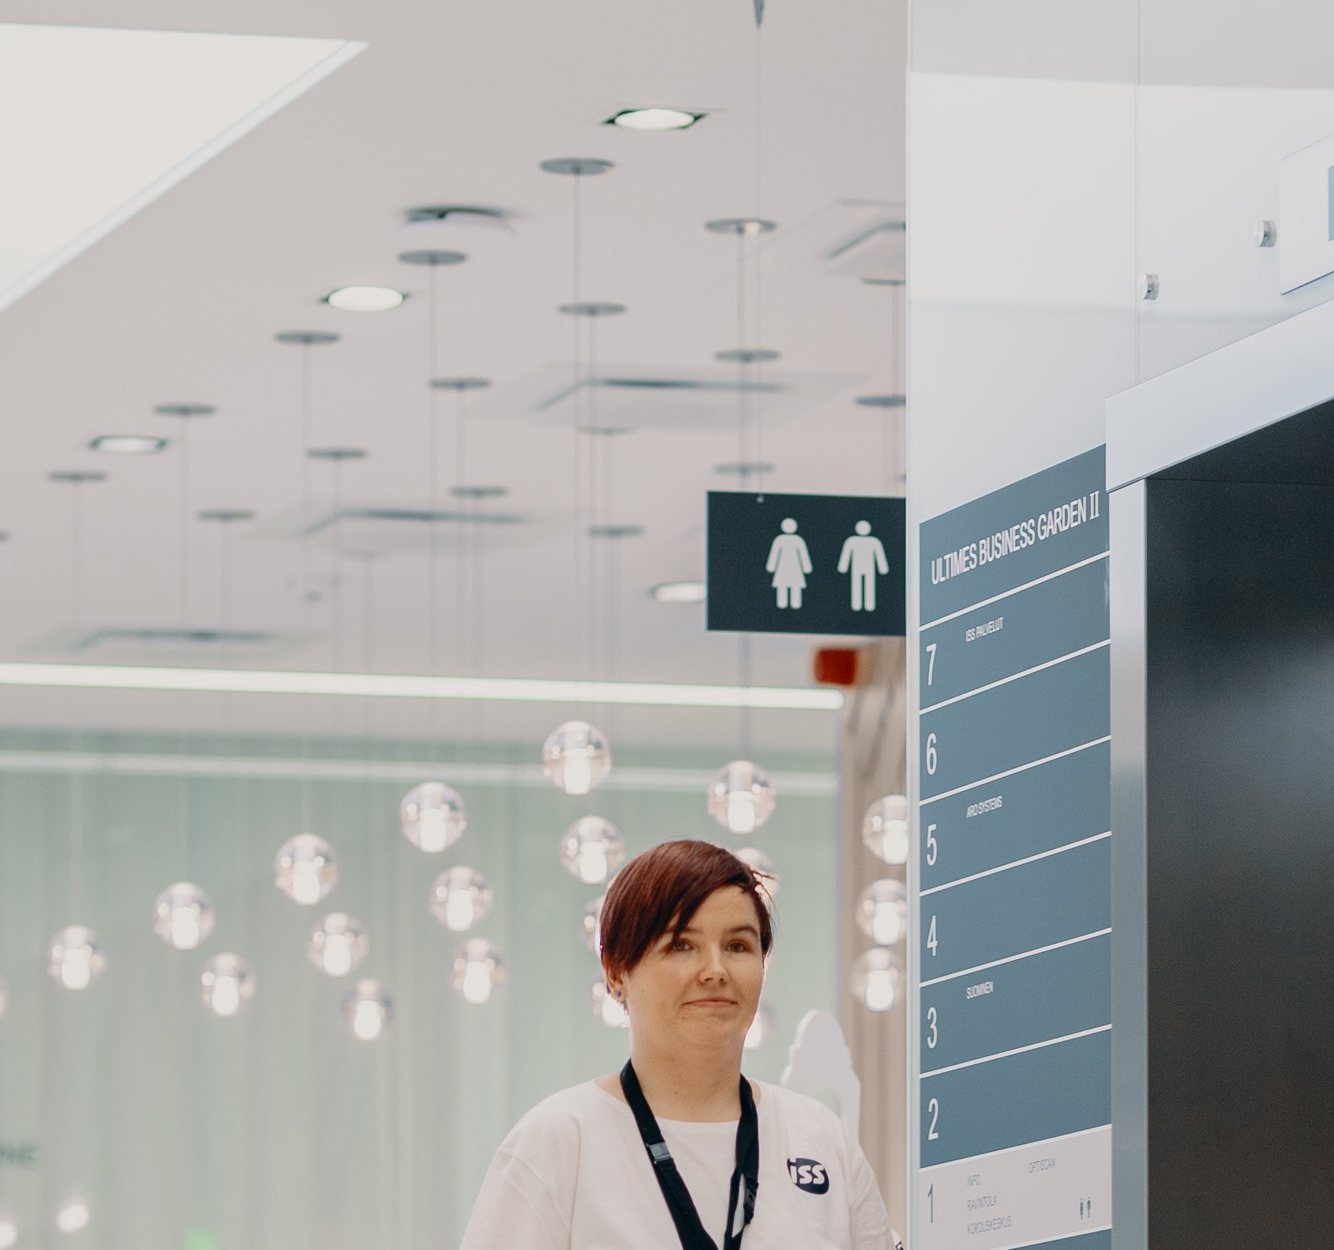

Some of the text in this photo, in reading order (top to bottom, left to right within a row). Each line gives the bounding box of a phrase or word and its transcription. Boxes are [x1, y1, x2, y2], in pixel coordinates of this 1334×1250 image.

[931, 490, 1100, 585] ULTIMES BUSINESS GARDEN II
[965, 616, 1004, 642] ISS PALVELUT
[925, 643, 937, 686] 7
[926, 733, 937, 775] 6
[978, 795, 1003, 815] SYSTEMS
[926, 823, 937, 866] 5
[926, 915, 938, 957] 4
[965, 980, 994, 1000] SUOMINEN
[927, 1007, 938, 1049] 3
[927, 1098, 939, 1141] 2
[927, 1183, 934, 1224] 1
